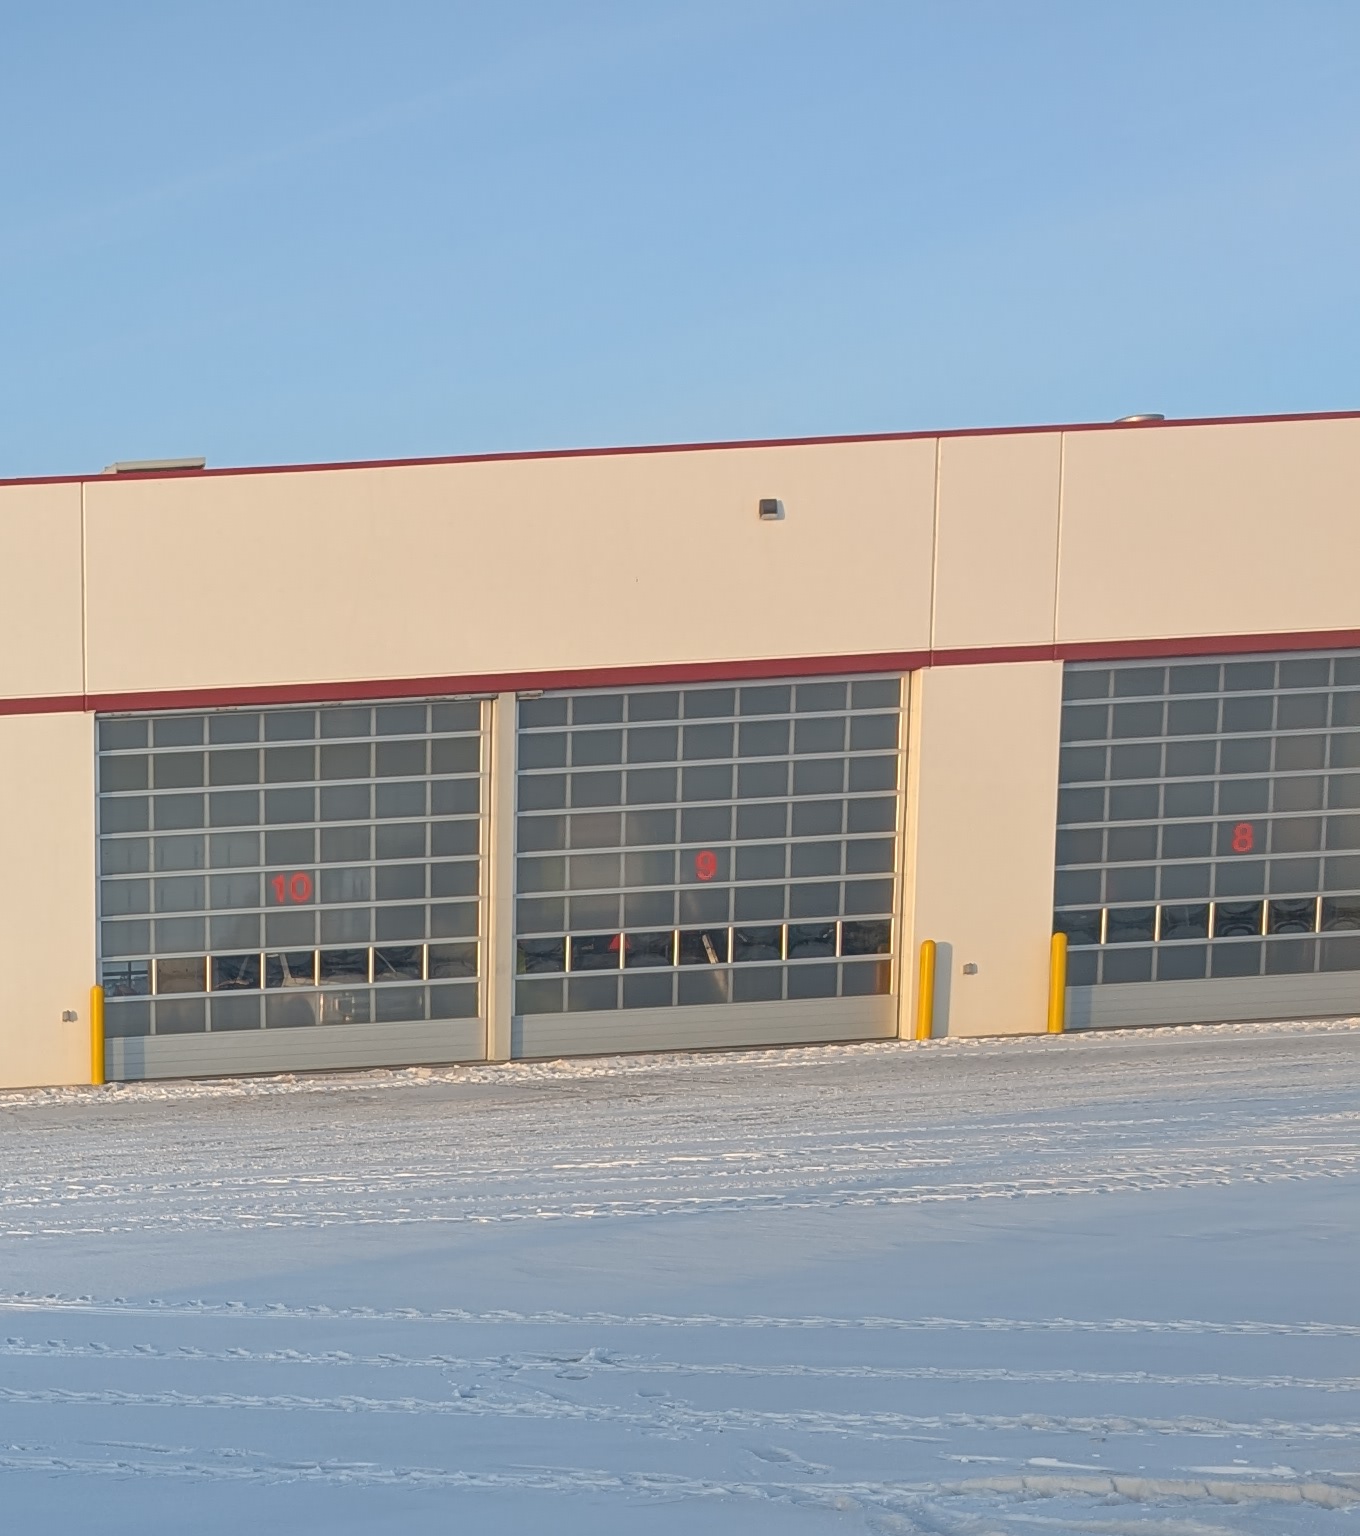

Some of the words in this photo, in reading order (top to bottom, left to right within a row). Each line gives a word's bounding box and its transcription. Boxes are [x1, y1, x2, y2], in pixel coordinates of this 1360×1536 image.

[1231, 822, 1253, 852] 8
[694, 850, 718, 880] 9
[271, 871, 312, 903] 10
